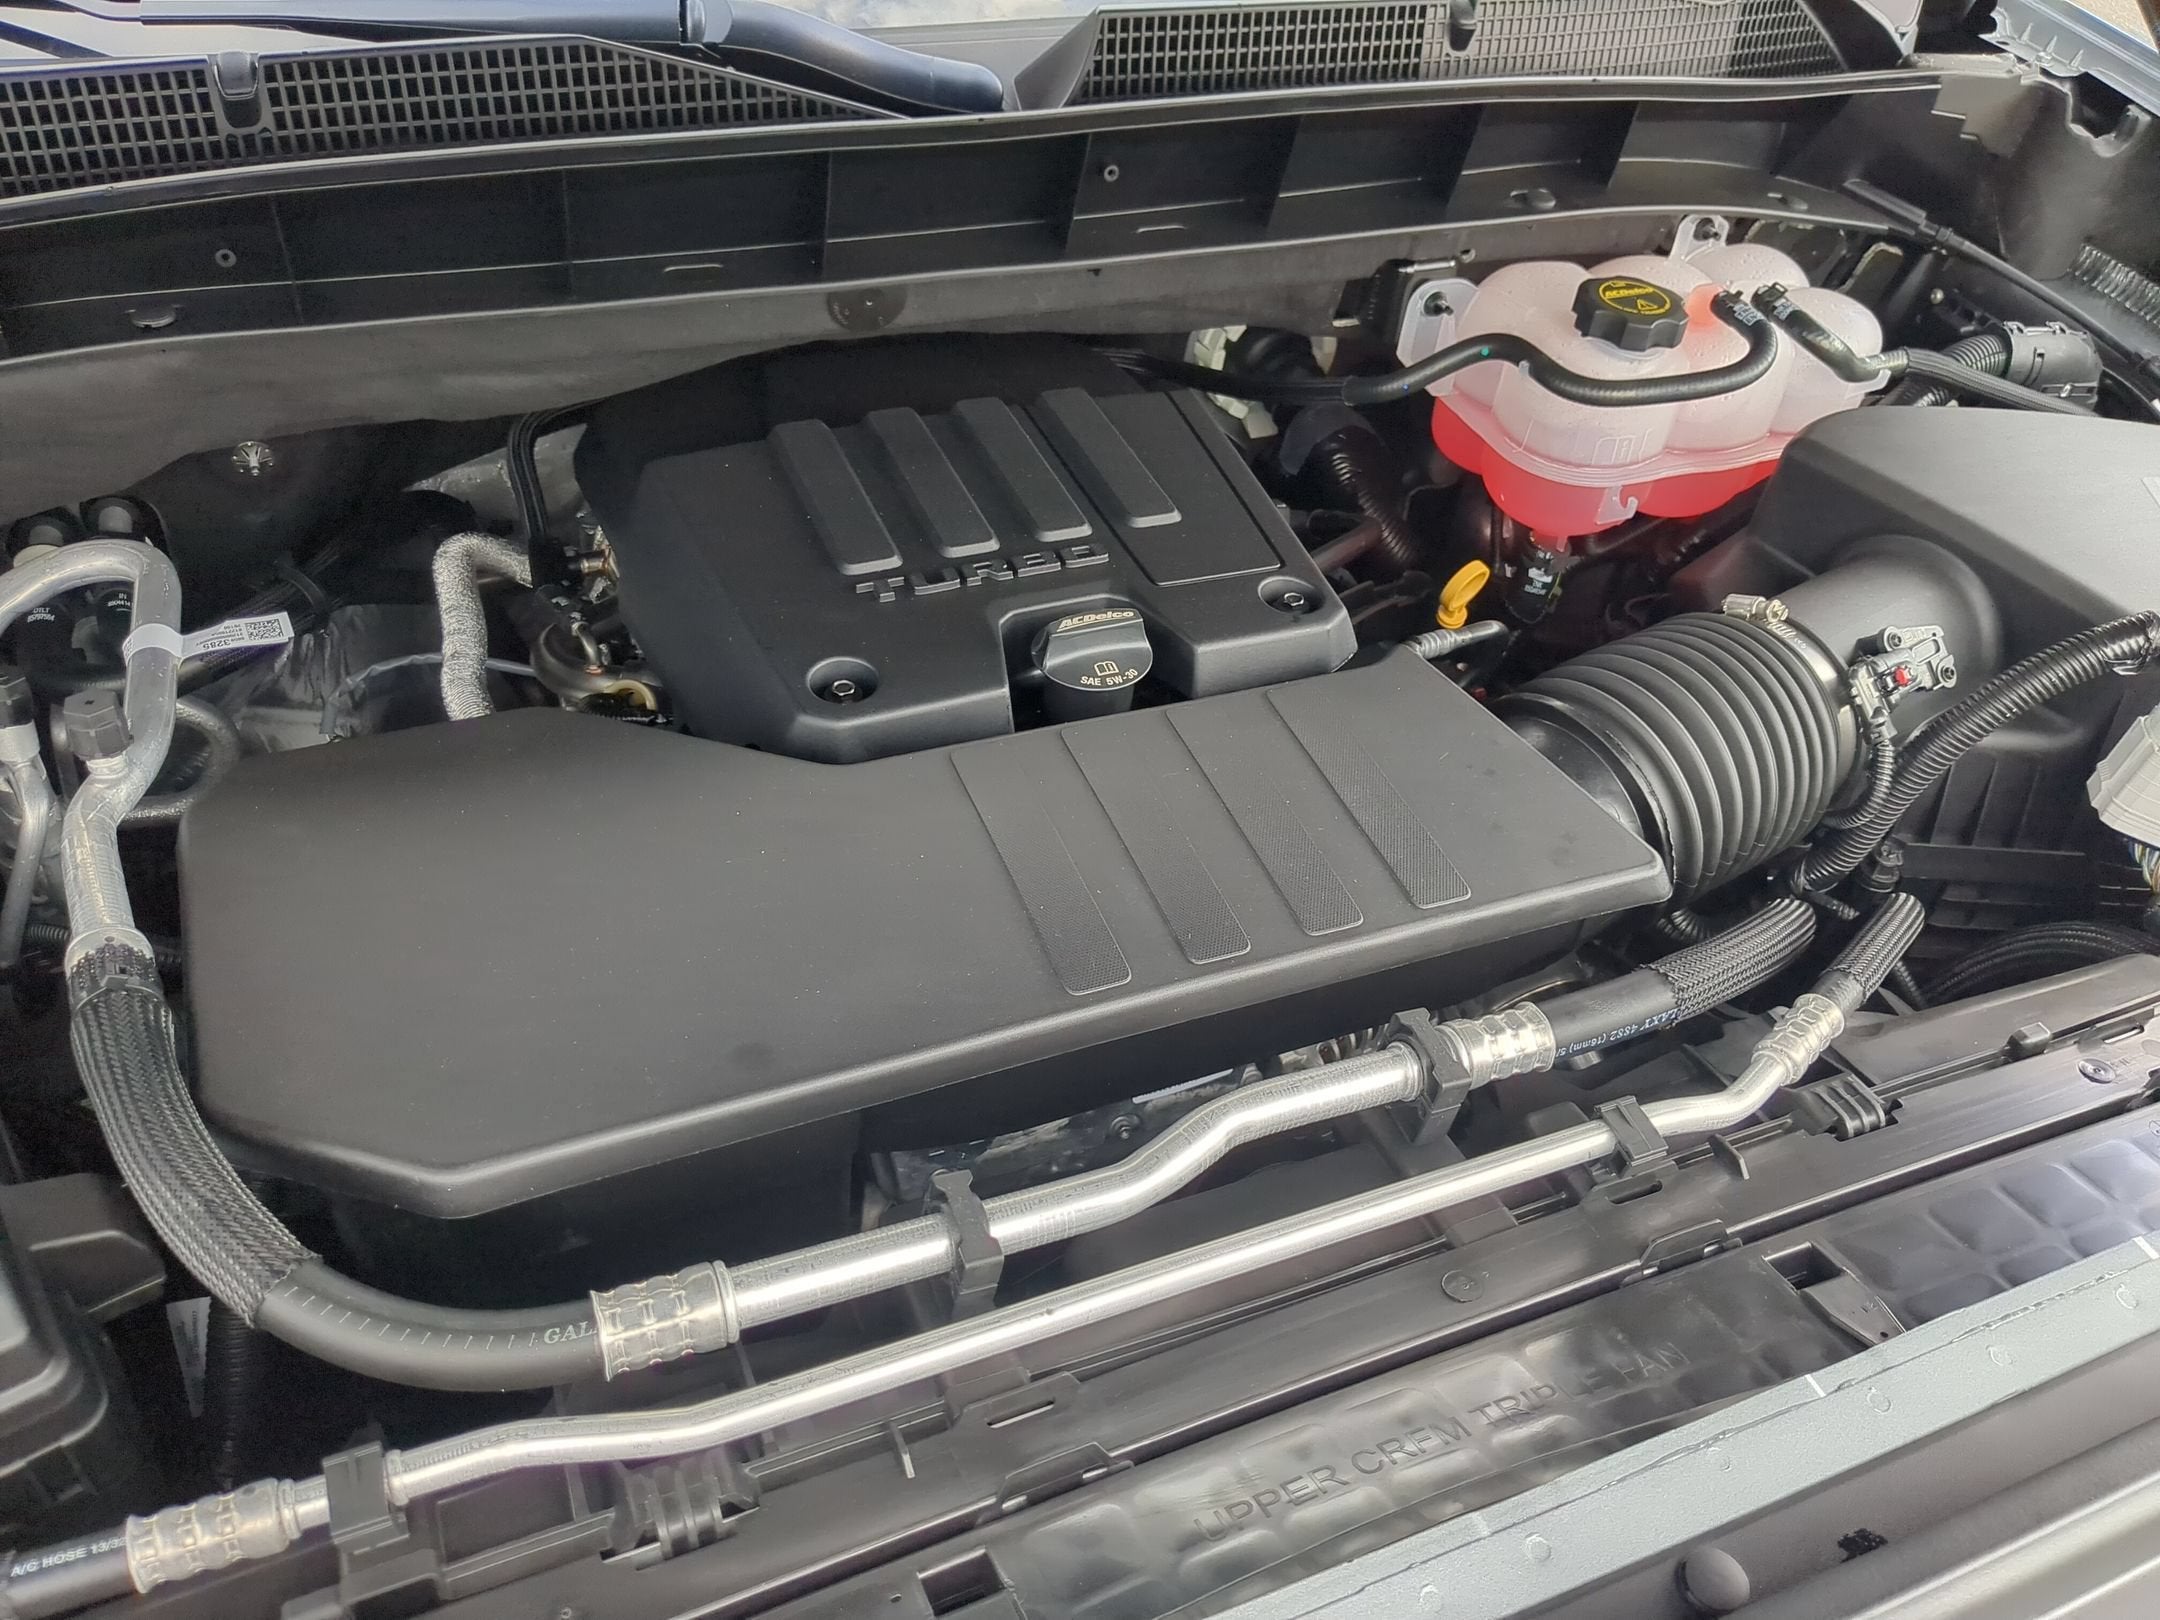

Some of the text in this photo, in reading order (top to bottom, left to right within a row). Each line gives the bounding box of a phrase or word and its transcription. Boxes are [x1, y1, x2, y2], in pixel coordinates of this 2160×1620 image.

[856, 545, 1109, 602] TURBO
[1056, 609, 1136, 632] ACDelco
[202, 639, 231, 651] 3285
[1080, 668, 1139, 686] SAE 5W-30
[1569, 1033, 1607, 1053] (16mm)
[1193, 1341, 1692, 1542] UPPER CRFM TRIPLE FAN
[10, 1559, 39, 1577] A/C
[42, 1547, 88, 1568] HOSE
